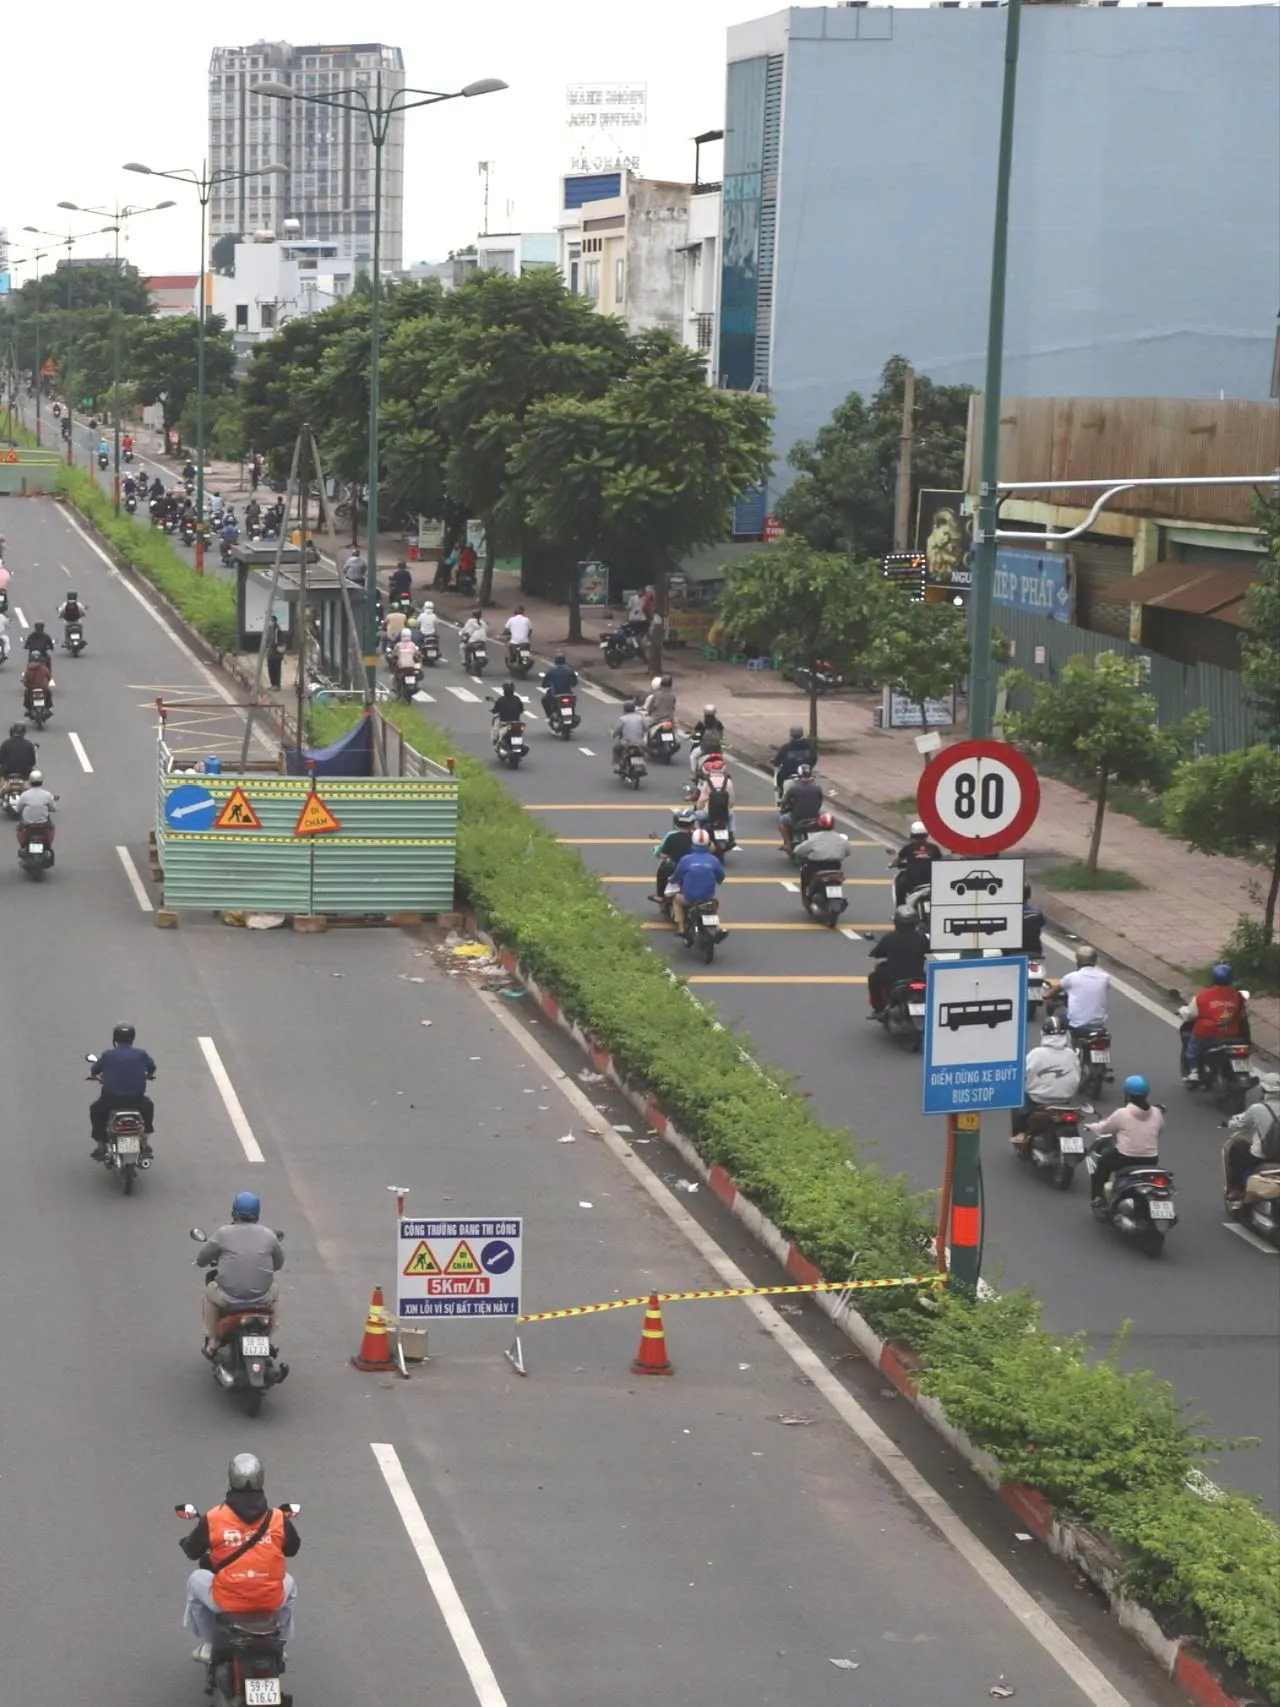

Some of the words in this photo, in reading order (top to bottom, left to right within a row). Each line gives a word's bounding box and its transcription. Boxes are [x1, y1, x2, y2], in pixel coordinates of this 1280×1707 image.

[1021, 570, 1055, 607] PHÁT
[954, 772, 1005, 820] 80
[930, 1067, 953, 1086] ĐIỂM
[955, 1068, 980, 1084] DỪNG
[982, 1069, 993, 1082] XE
[995, 1064, 1018, 1082] BUÝT
[952, 1088, 970, 1104] BUS
[972, 1087, 995, 1102] STOP
[404, 1223, 425, 1236] CÔNG
[427, 1221, 457, 1236] TRƯỜNG
[459, 1223, 480, 1235] ĐANG
[482, 1223, 494, 1235] THI
[495, 1222, 517, 1235] CÔNG
[431, 1278, 486, 1294] 5Km/h
[405, 1303, 418, 1314] XIN
[420, 1300, 433, 1314] LỖI
[434, 1302, 442, 1313] VÌ
[444, 1303, 455, 1315] SỰ
[456, 1300, 472, 1313] BẤT
[474, 1301, 491, 1315] TIỆN
[493, 1301, 508, 1313] NÀY
